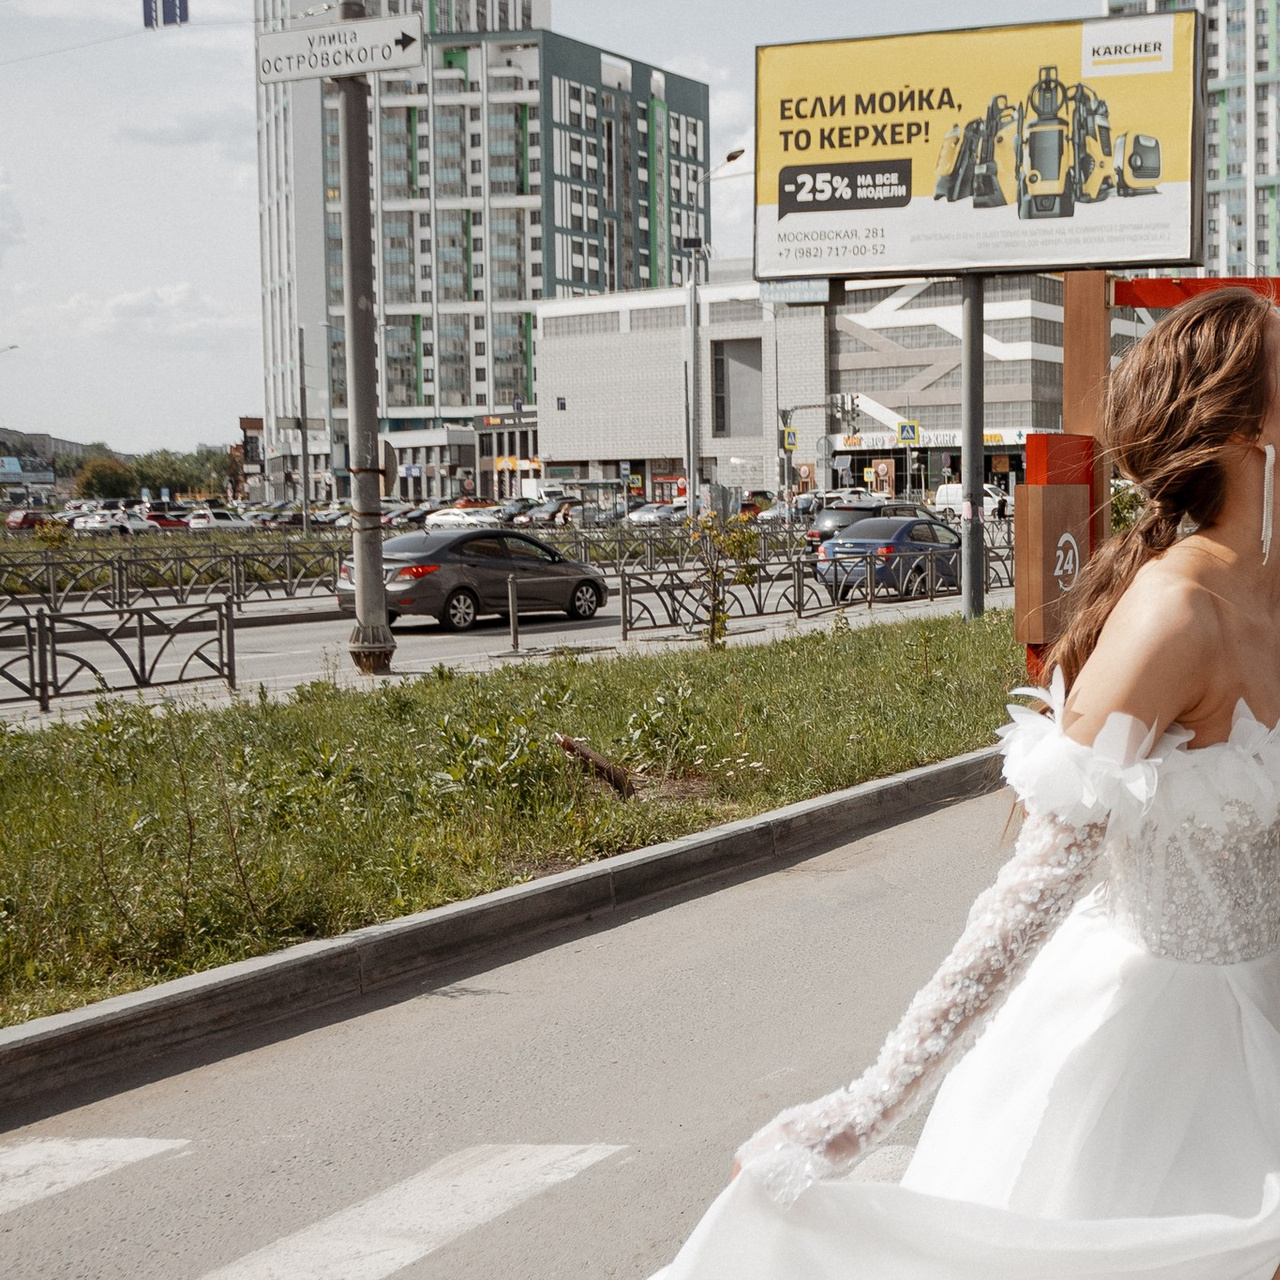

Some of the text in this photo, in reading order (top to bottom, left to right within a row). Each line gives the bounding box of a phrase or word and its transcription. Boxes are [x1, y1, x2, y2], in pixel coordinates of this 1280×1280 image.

[307, 31, 358, 52] улица
[261, 44, 392, 75] ОСТРОВСКОГО
[780, 84, 962, 120] ЕСЛИ МОЙКА,
[780, 121, 930, 151] ТО КЕРХЕР!
[784, 172, 852, 202] -25%
[857, 173, 899, 186] НА ВСЕ
[857, 184, 906, 200] МОДЕЛИ
[778, 227, 885, 243] МОСКОВСКАЯ, 281
[778, 244, 886, 261] +7 (982) 717-00-52
[1054, 549, 1074, 576] 24
